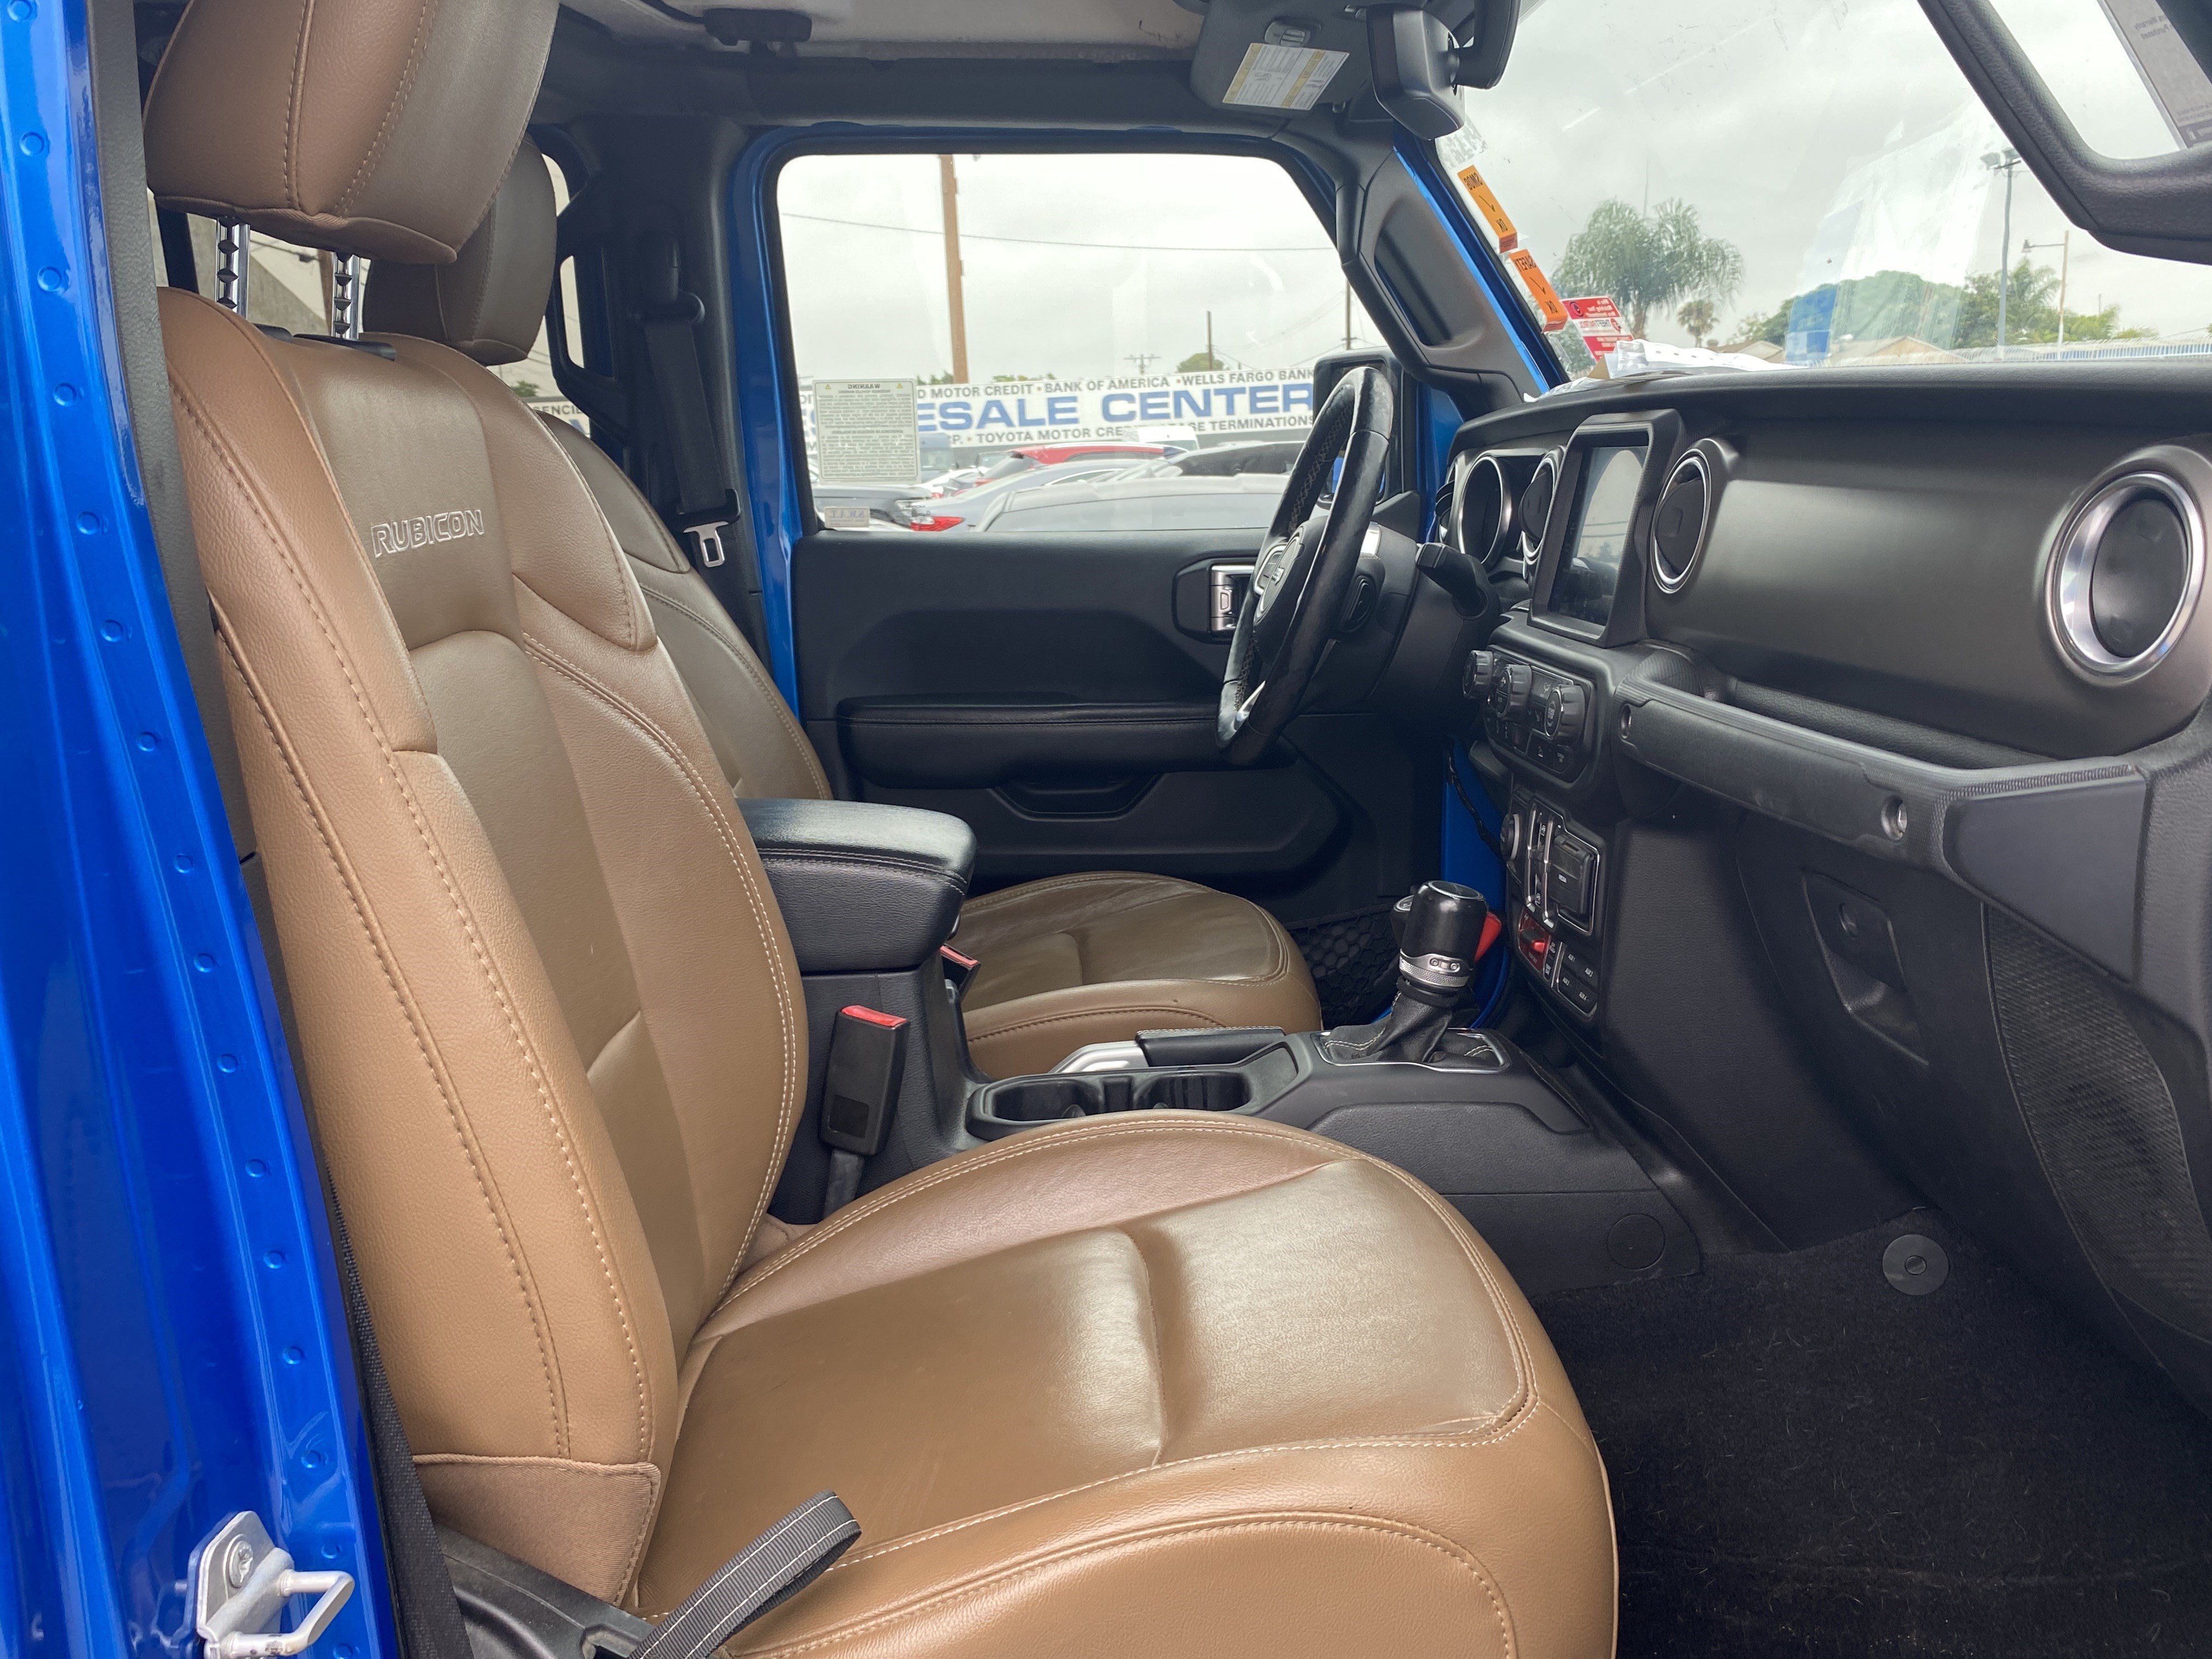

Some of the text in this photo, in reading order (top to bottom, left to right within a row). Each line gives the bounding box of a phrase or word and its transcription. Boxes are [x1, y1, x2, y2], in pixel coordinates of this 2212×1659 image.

[931, 387, 980, 398] MOTOR
[984, 384, 1034, 396] CREDIT
[1045, 381, 1082, 393] BANK
[1087, 380, 1104, 391] OF
[1108, 377, 1171, 390] AMERICA
[1182, 374, 1224, 386] WELLS
[1229, 371, 1273, 383] FARGO
[1278, 369, 1314, 380] BANK
[1102, 383, 1313, 422] CENTER
[977, 431, 1033, 443] TOYOTA
[1038, 428, 1091, 440] MOTOR
[1210, 416, 1313, 431] TERMINATIONS
[370, 509, 485, 558] RUBICON
